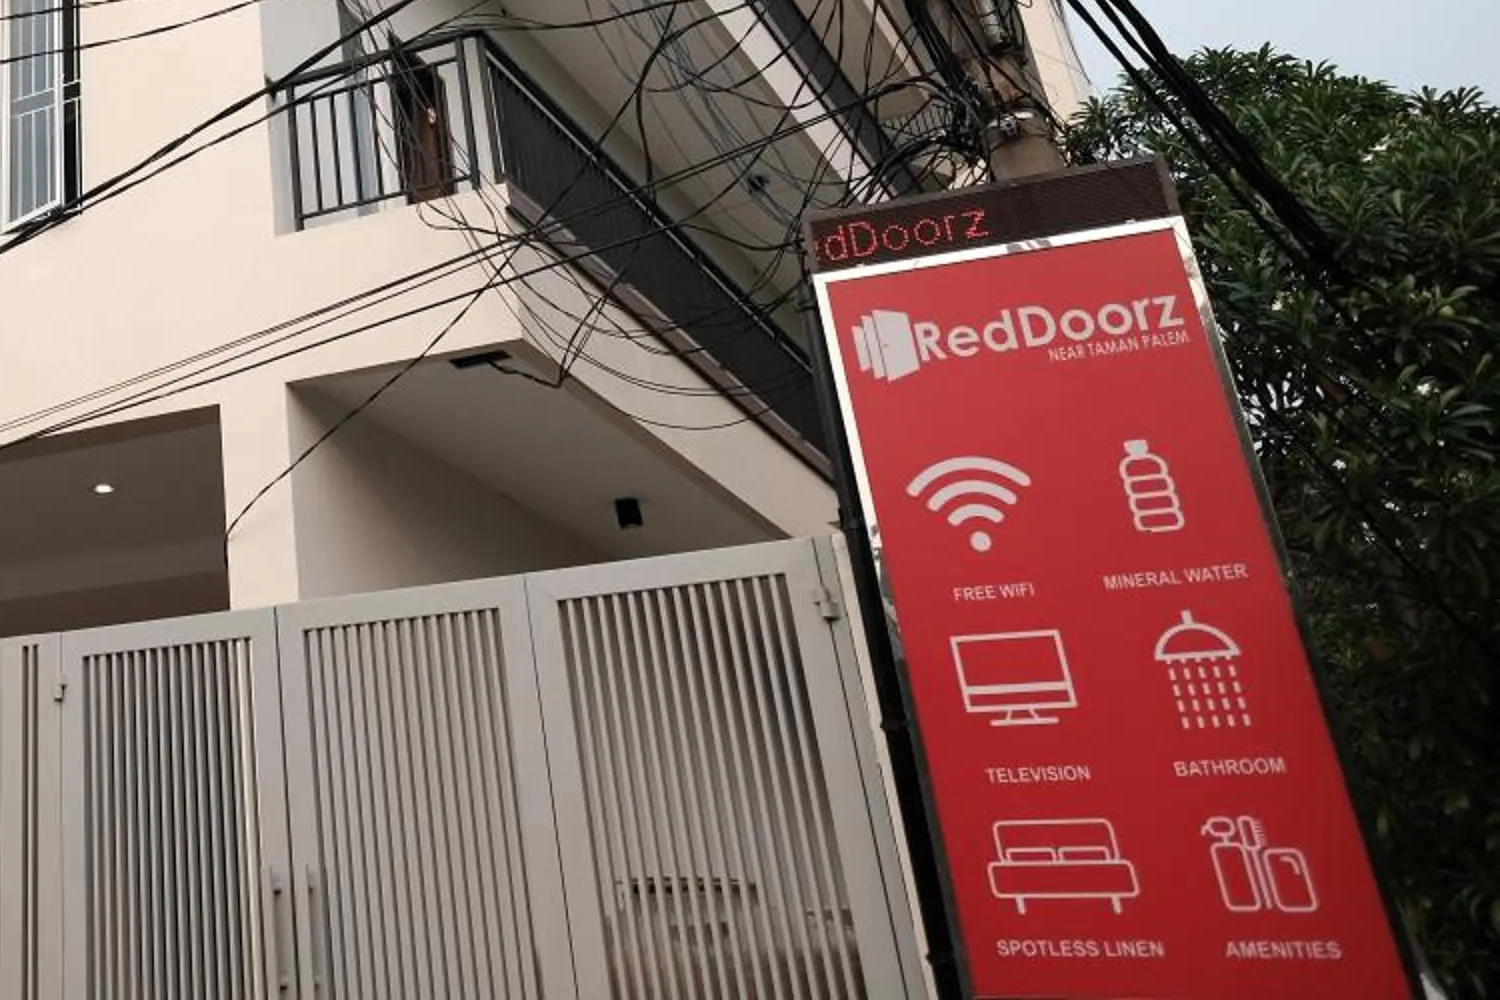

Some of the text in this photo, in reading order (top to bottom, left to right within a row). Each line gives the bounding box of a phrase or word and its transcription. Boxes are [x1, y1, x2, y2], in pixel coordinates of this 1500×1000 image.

[913, 295, 1185, 362] RedDoorz
[1048, 330, 1190, 363] NEAR TAMAN PALEM
[1102, 563, 1249, 591] MINERAL WATER
[953, 582, 1035, 601] FREE WIFI
[985, 765, 1092, 784] TELEVISION
[1173, 757, 1287, 778] BATHROOM
[997, 939, 1165, 958] SPOTLESS LINEN
[1225, 940, 1343, 960] AMENITIES
